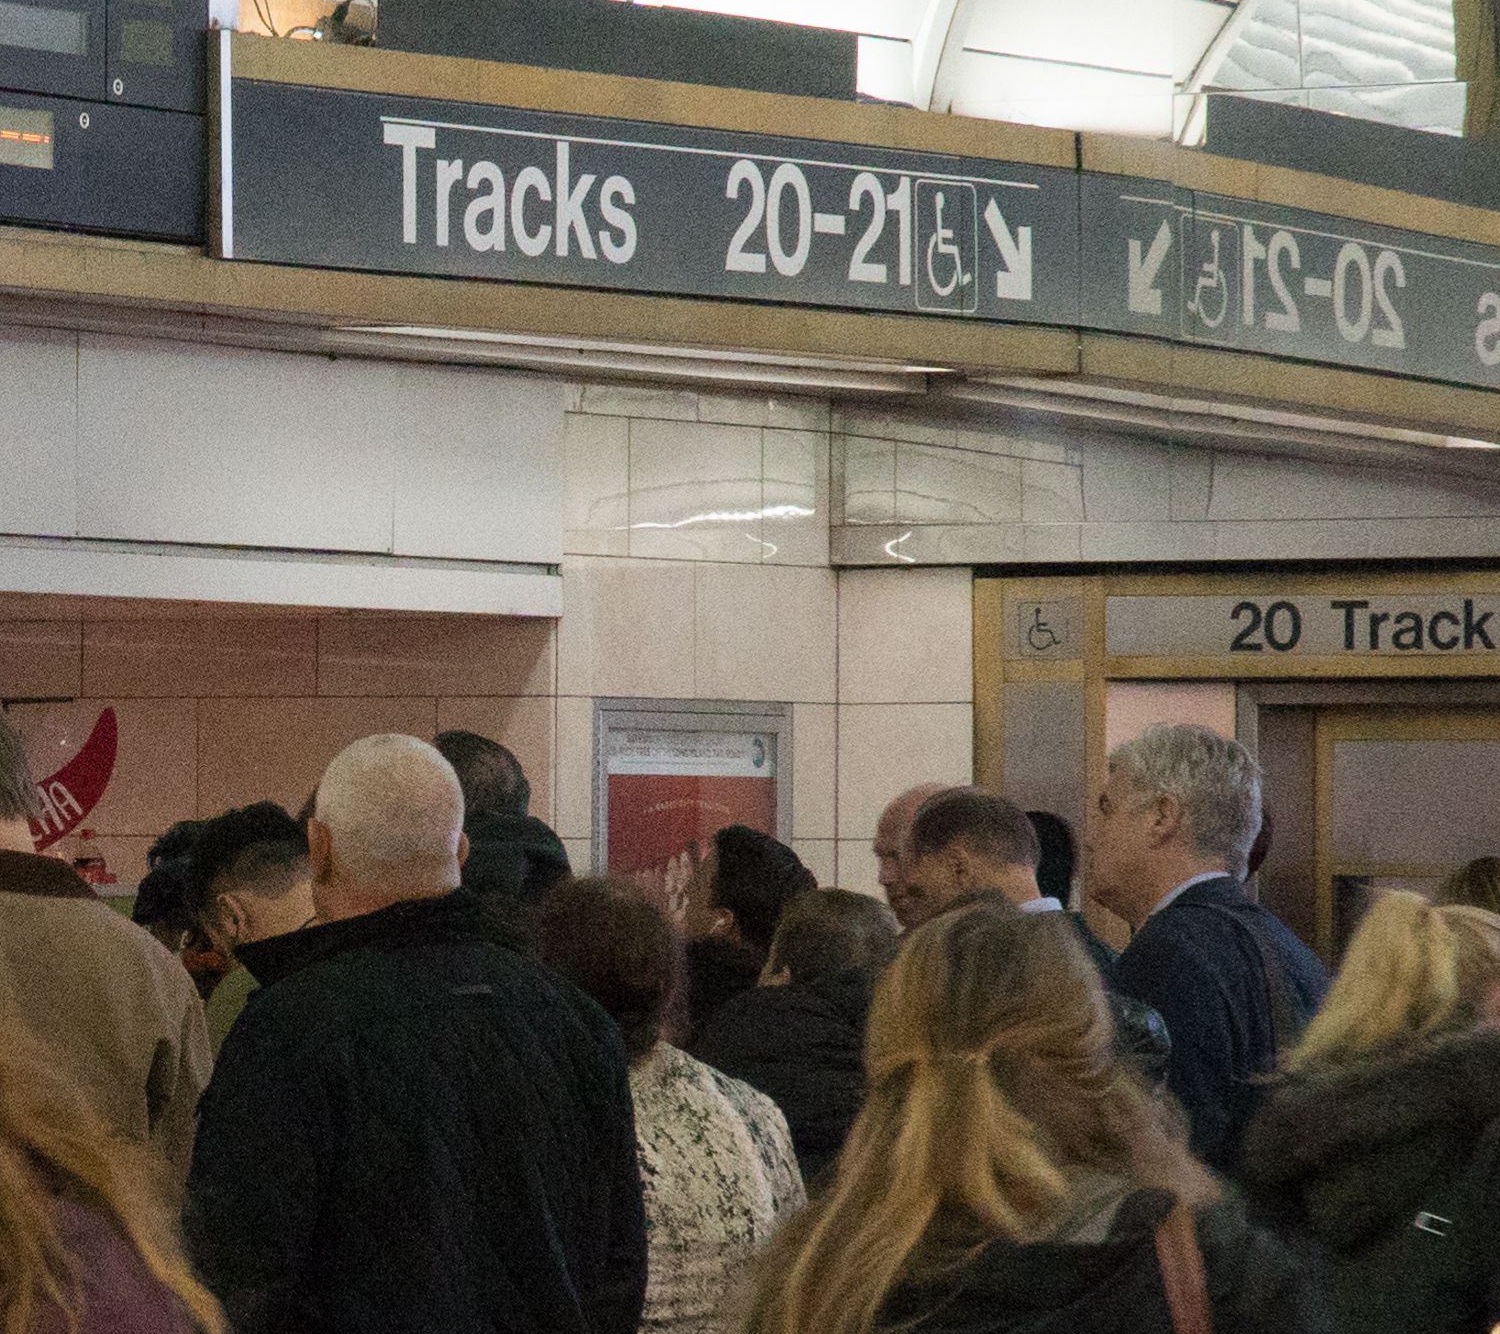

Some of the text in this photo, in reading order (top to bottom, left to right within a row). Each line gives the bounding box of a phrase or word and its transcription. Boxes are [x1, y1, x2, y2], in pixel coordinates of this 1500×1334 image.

[383, 122, 912, 287] Tracks 20-21
[1230, 600, 1301, 652] 20
[1332, 598, 1496, 650] Track
